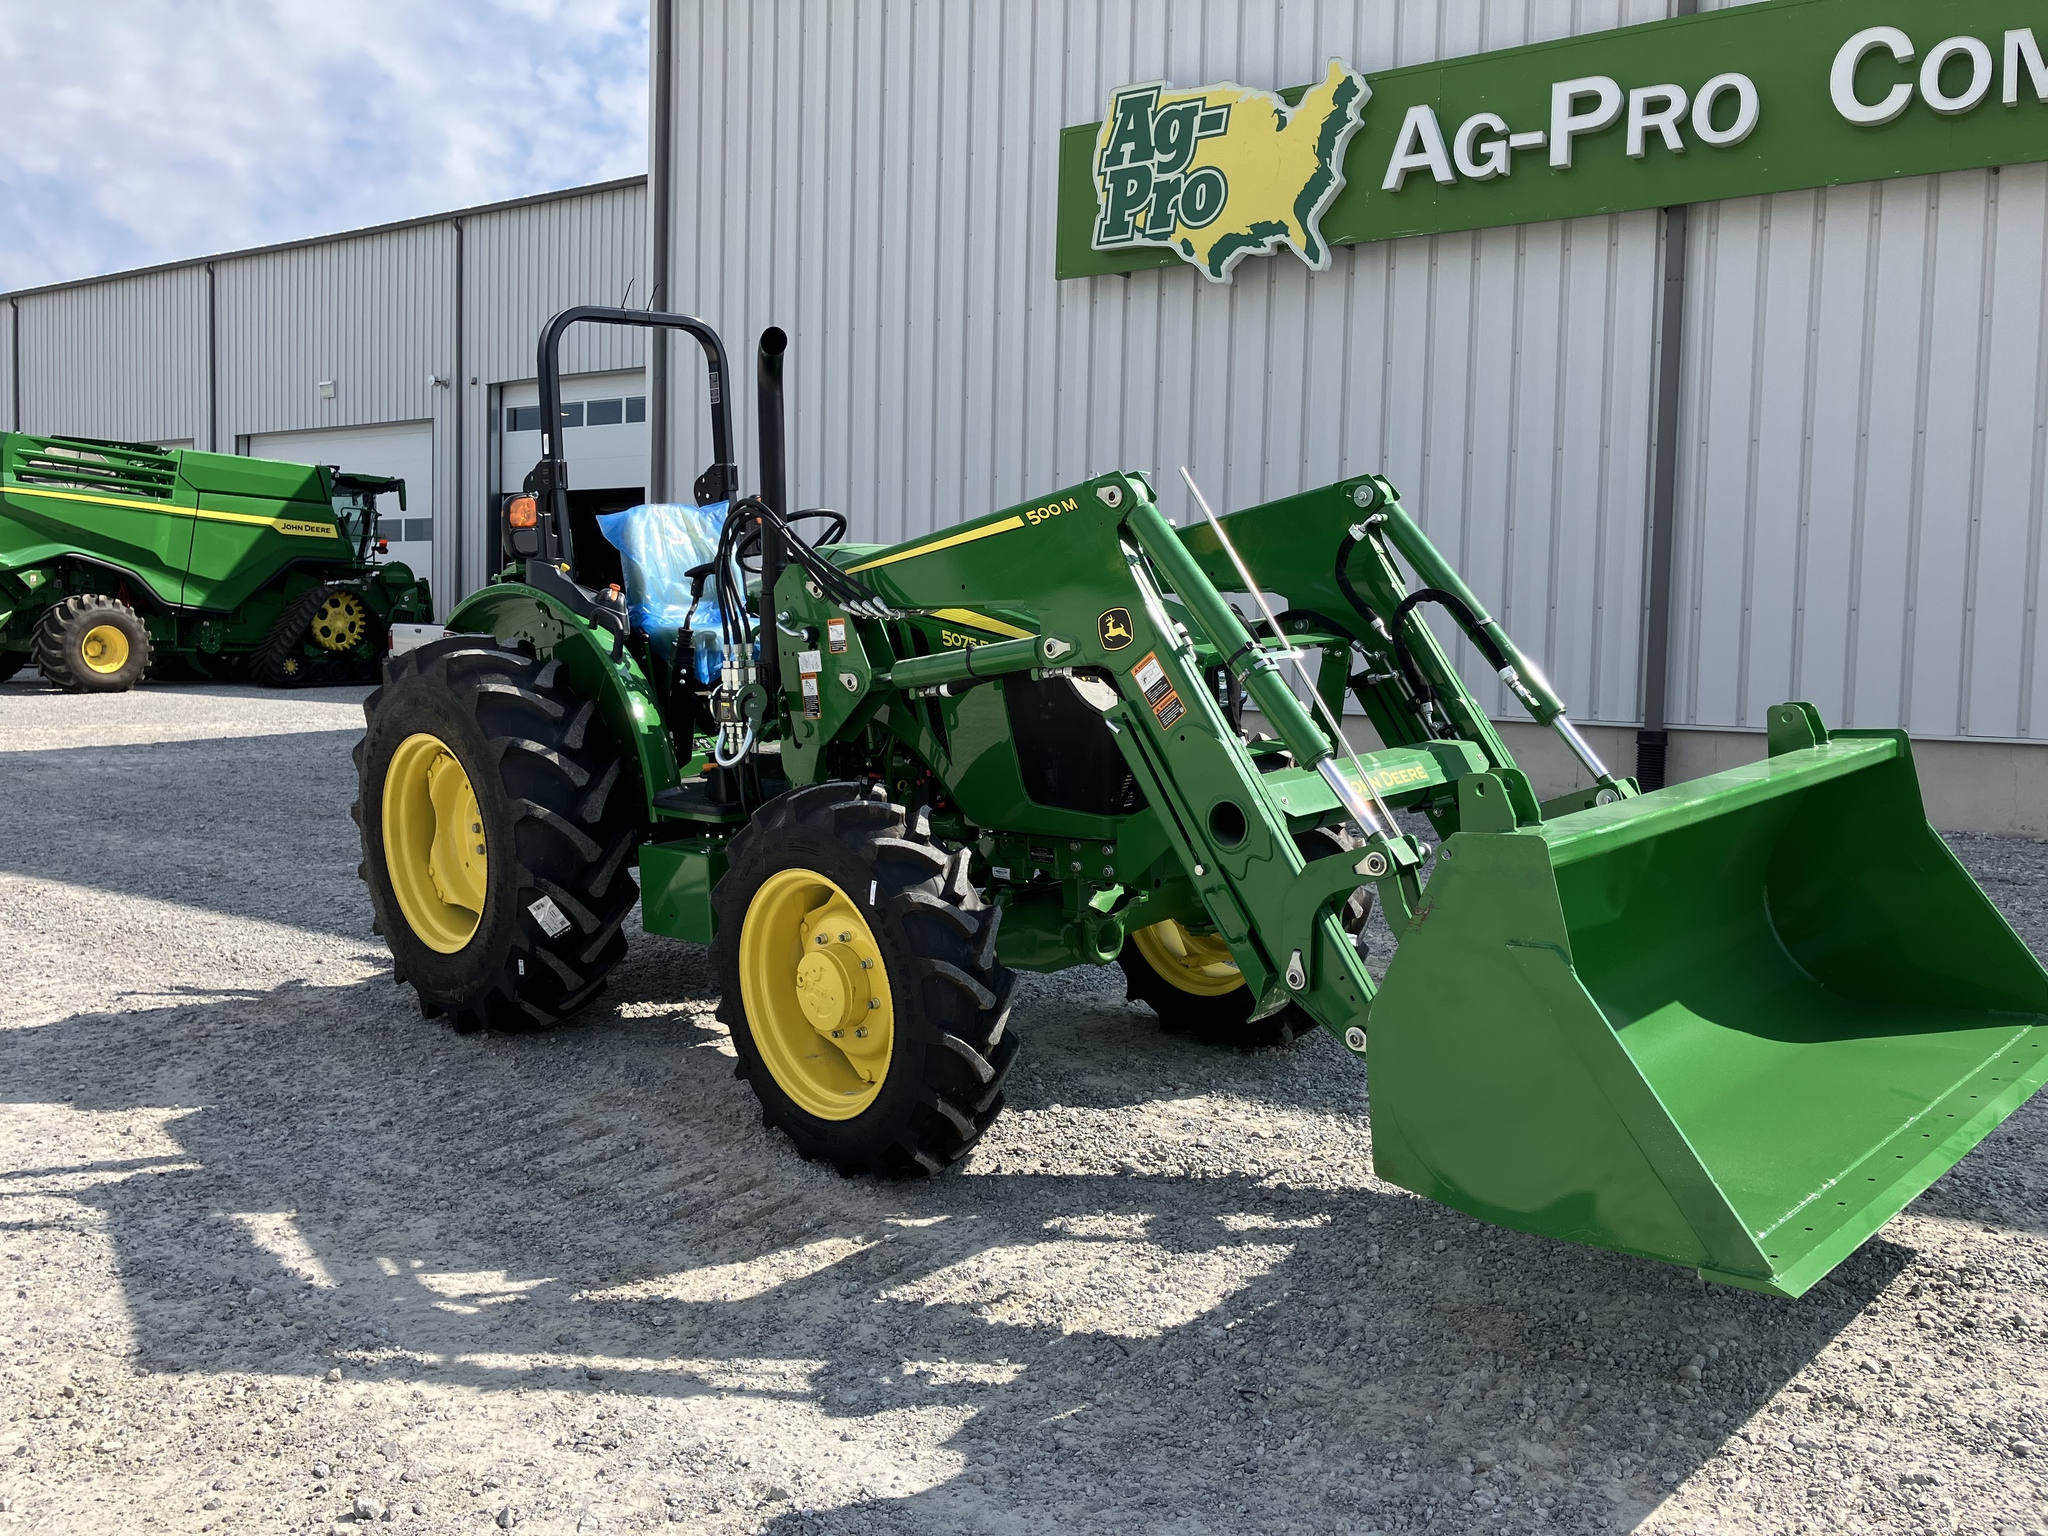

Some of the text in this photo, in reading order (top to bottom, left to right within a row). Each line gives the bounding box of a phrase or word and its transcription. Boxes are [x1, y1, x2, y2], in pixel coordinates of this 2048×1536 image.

[1098, 85, 1232, 176] Ag-
[1096, 165, 1229, 246] Pro
[281, 522, 331, 534] JOHN DEERE
[941, 629, 978, 649] 5075
[1379, 766, 1429, 787] DEERE
